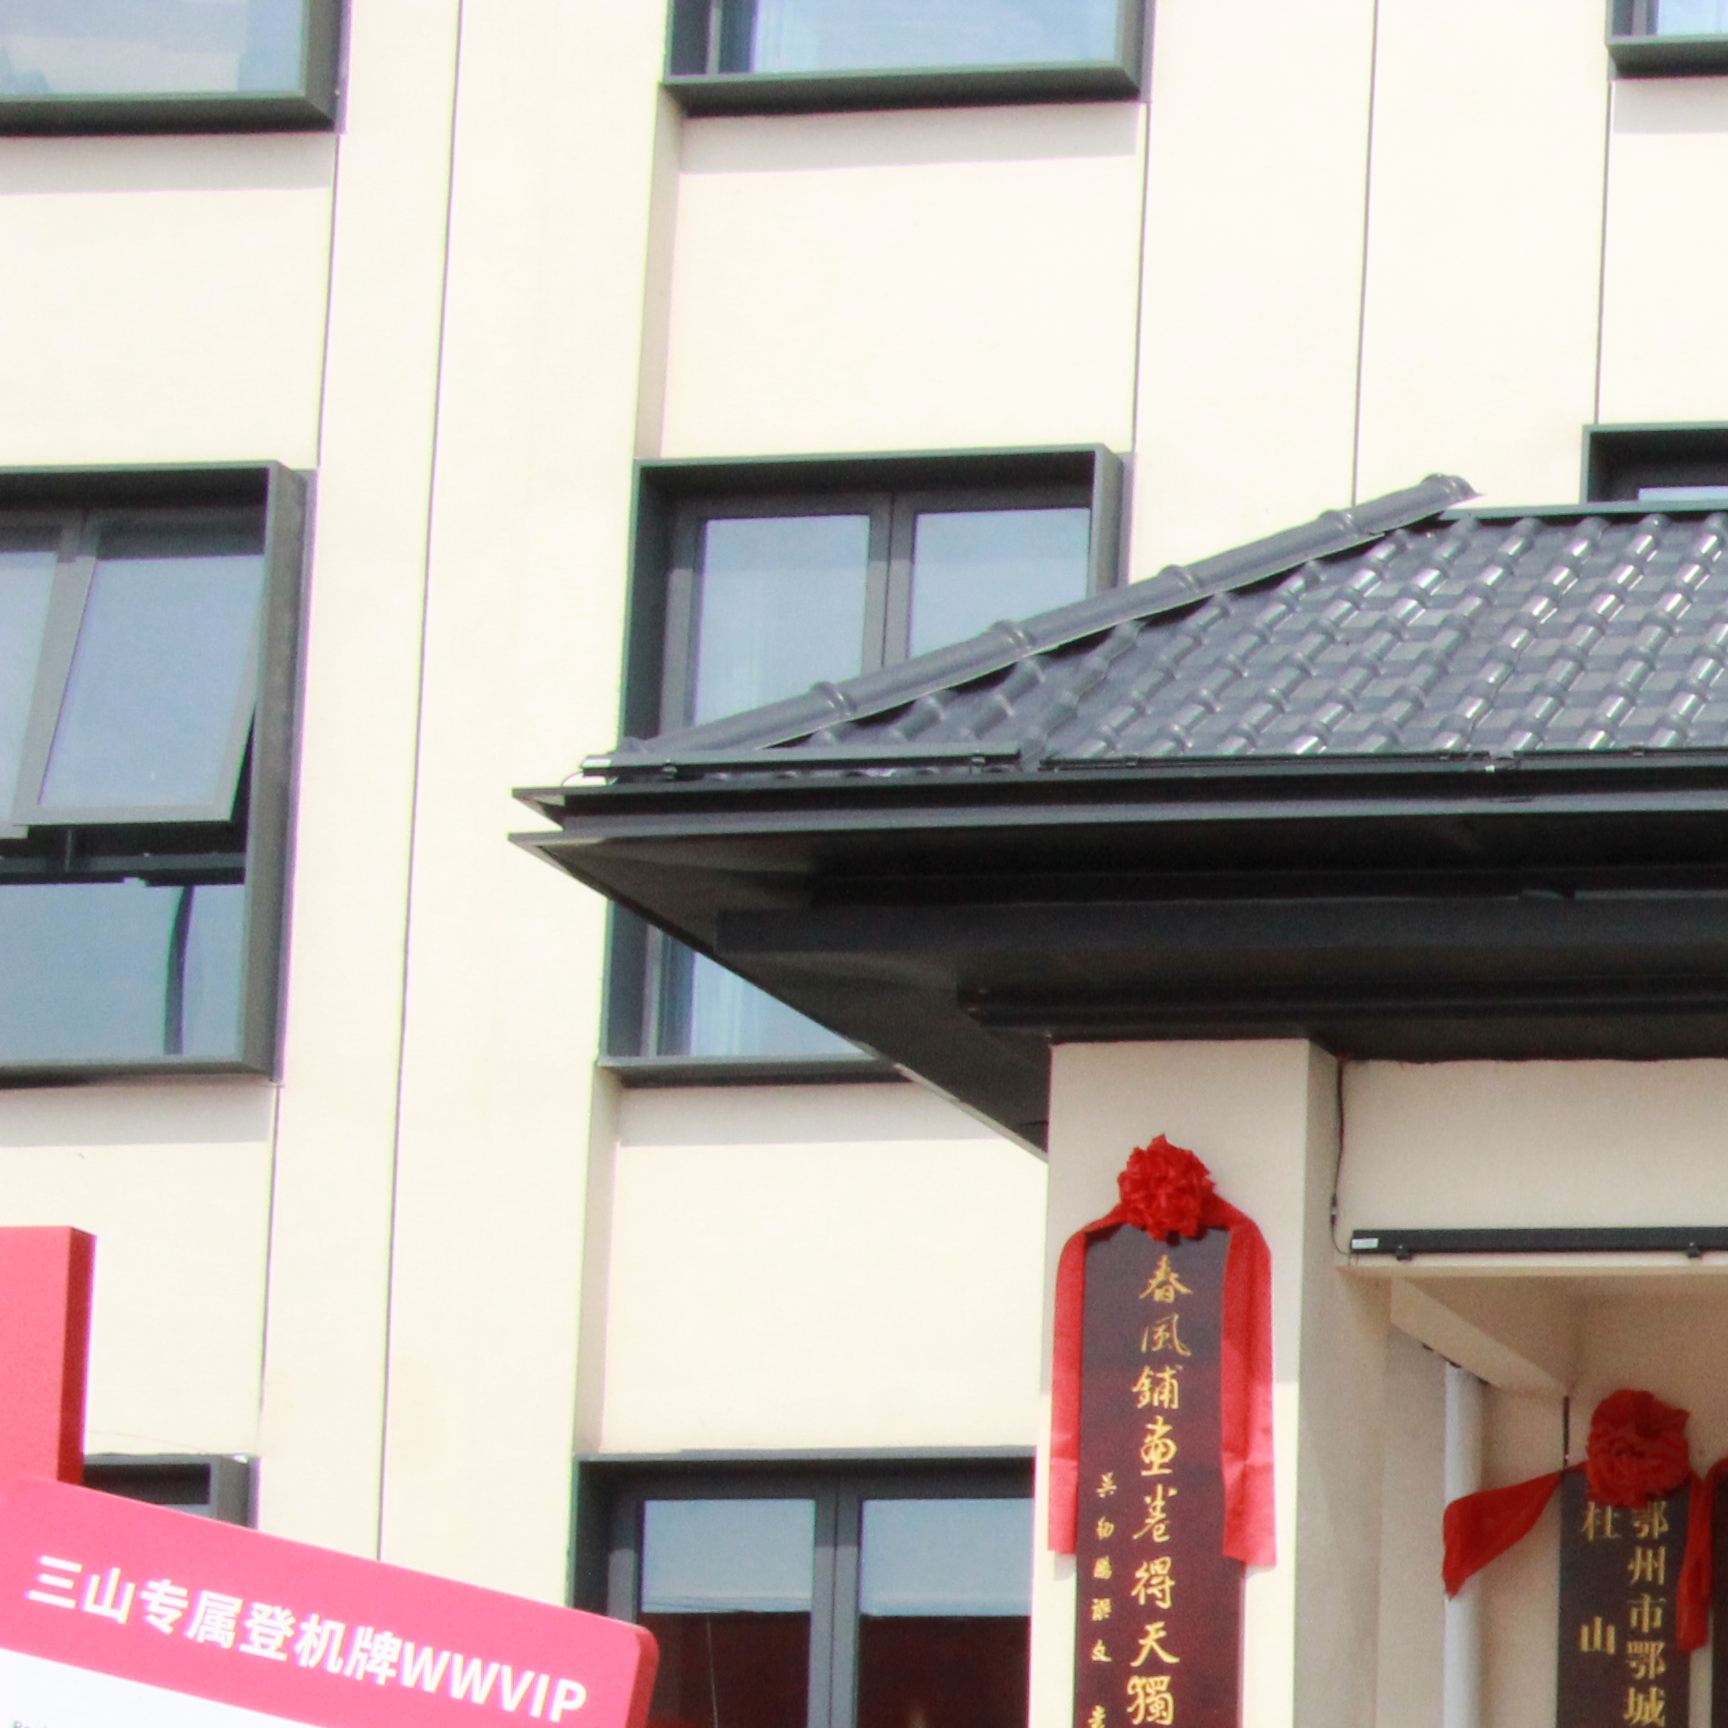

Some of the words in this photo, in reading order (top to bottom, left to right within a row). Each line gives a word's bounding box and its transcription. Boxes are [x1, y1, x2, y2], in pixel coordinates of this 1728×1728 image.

[25, 1555, 589, 1724] 三山专属登机牌WWVIP
